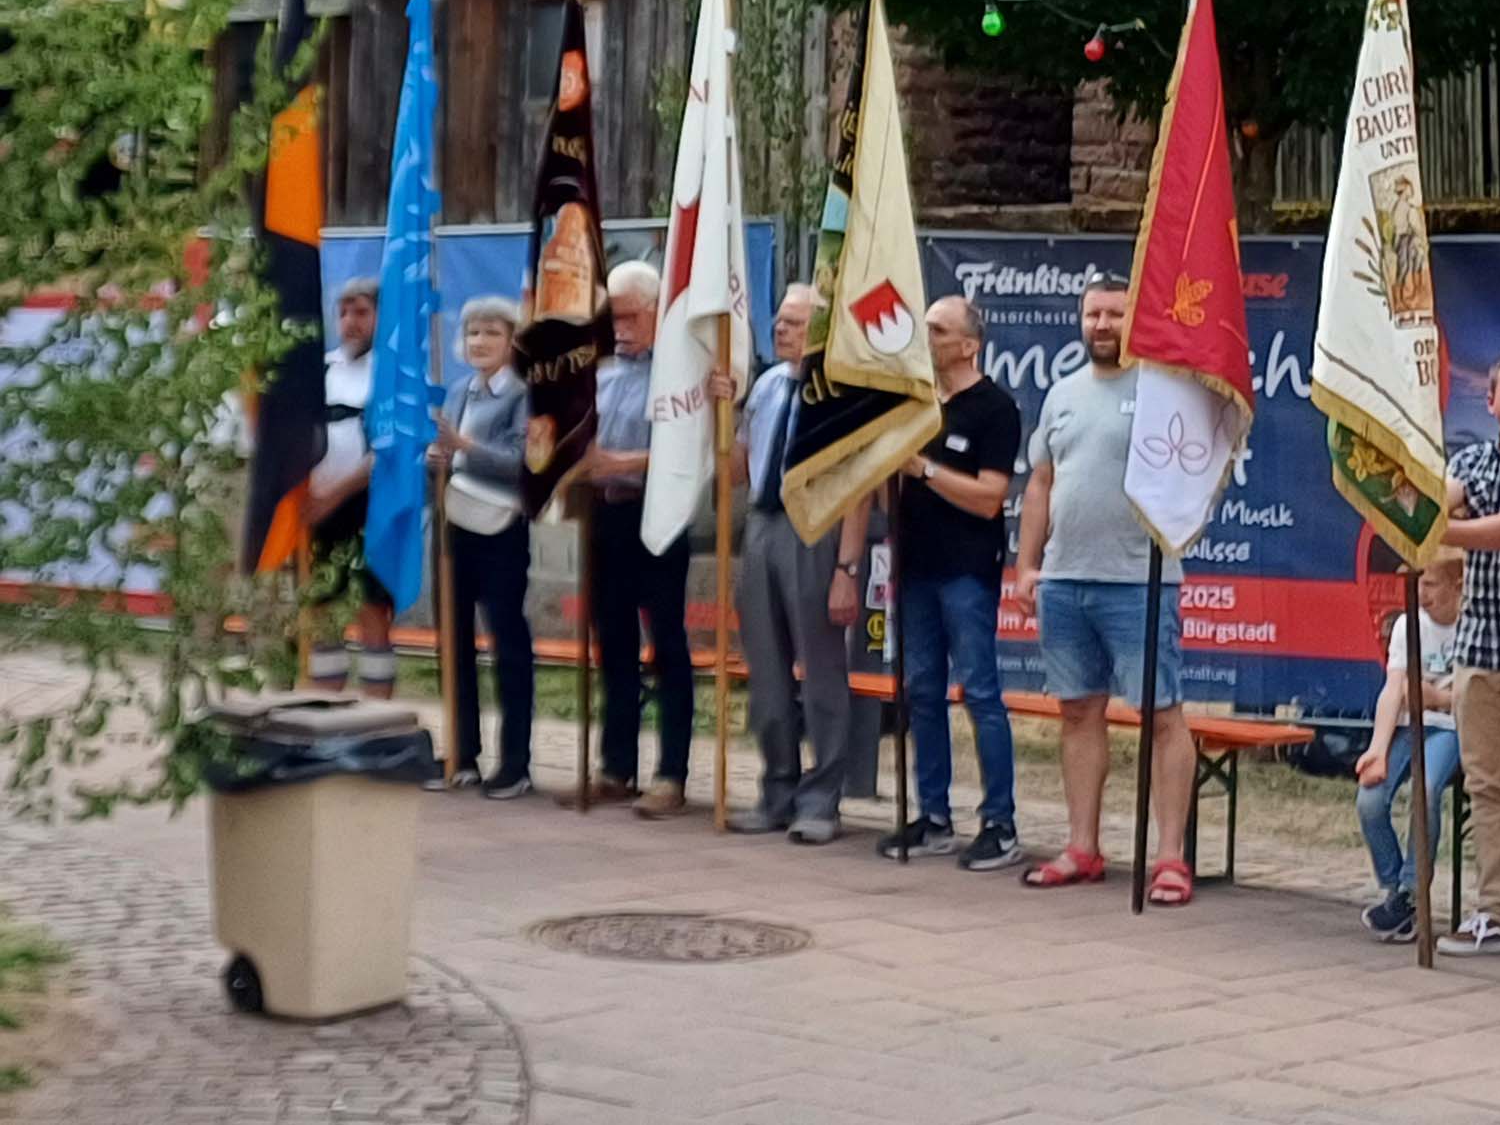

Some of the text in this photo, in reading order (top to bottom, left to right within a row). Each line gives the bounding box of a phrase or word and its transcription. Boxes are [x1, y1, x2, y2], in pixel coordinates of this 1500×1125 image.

[979, 309, 1077, 326] lasorcheste
[1221, 499, 1294, 528] Musik
[1184, 537, 1250, 563] ulisse
[1179, 585, 1236, 610] 2025
[1183, 617, 1278, 645] Bürgstadt
